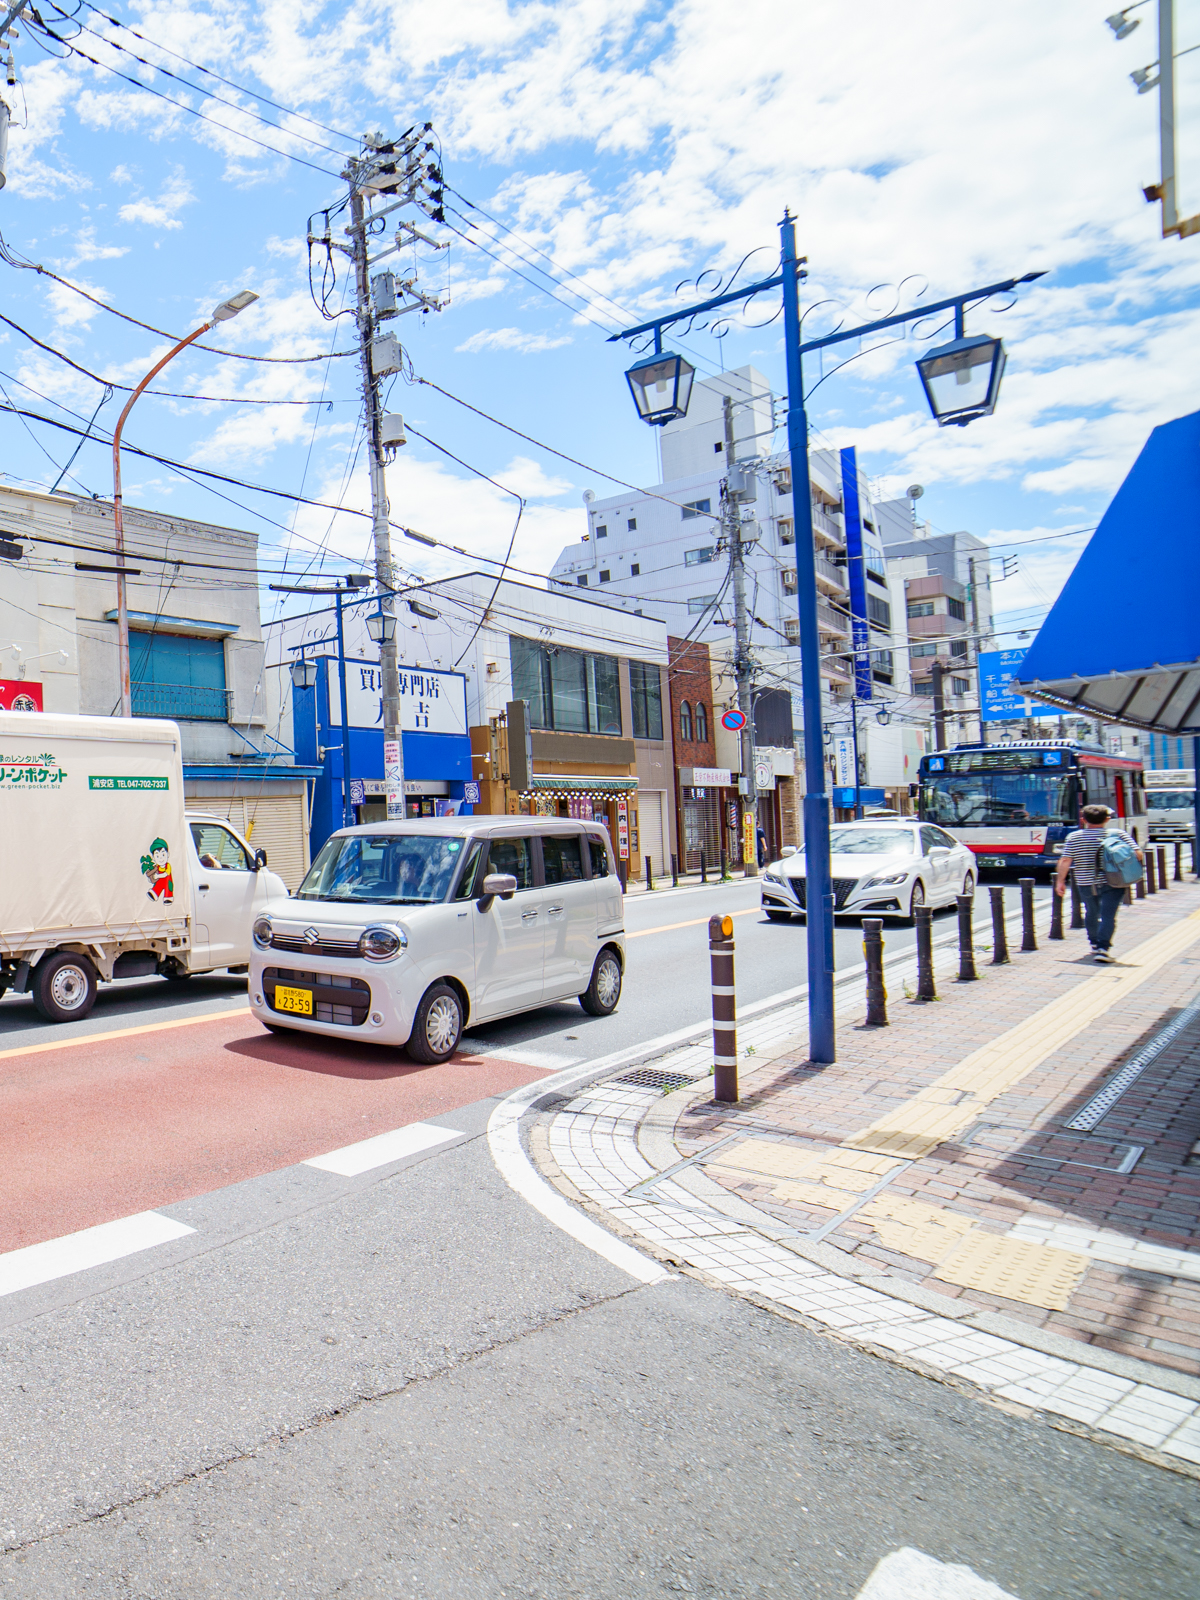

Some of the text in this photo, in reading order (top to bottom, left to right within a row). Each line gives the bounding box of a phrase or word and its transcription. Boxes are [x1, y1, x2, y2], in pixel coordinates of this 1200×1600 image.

[1000, 649, 1029, 660] 本八
[985, 673, 1013, 683] 千葉
[92, 778, 115, 788] 浦安店
[618, 802, 628, 857] 店内喫煙可
[993, 859, 1006, 867] 63
[283, 996, 310, 1012] 23-59
